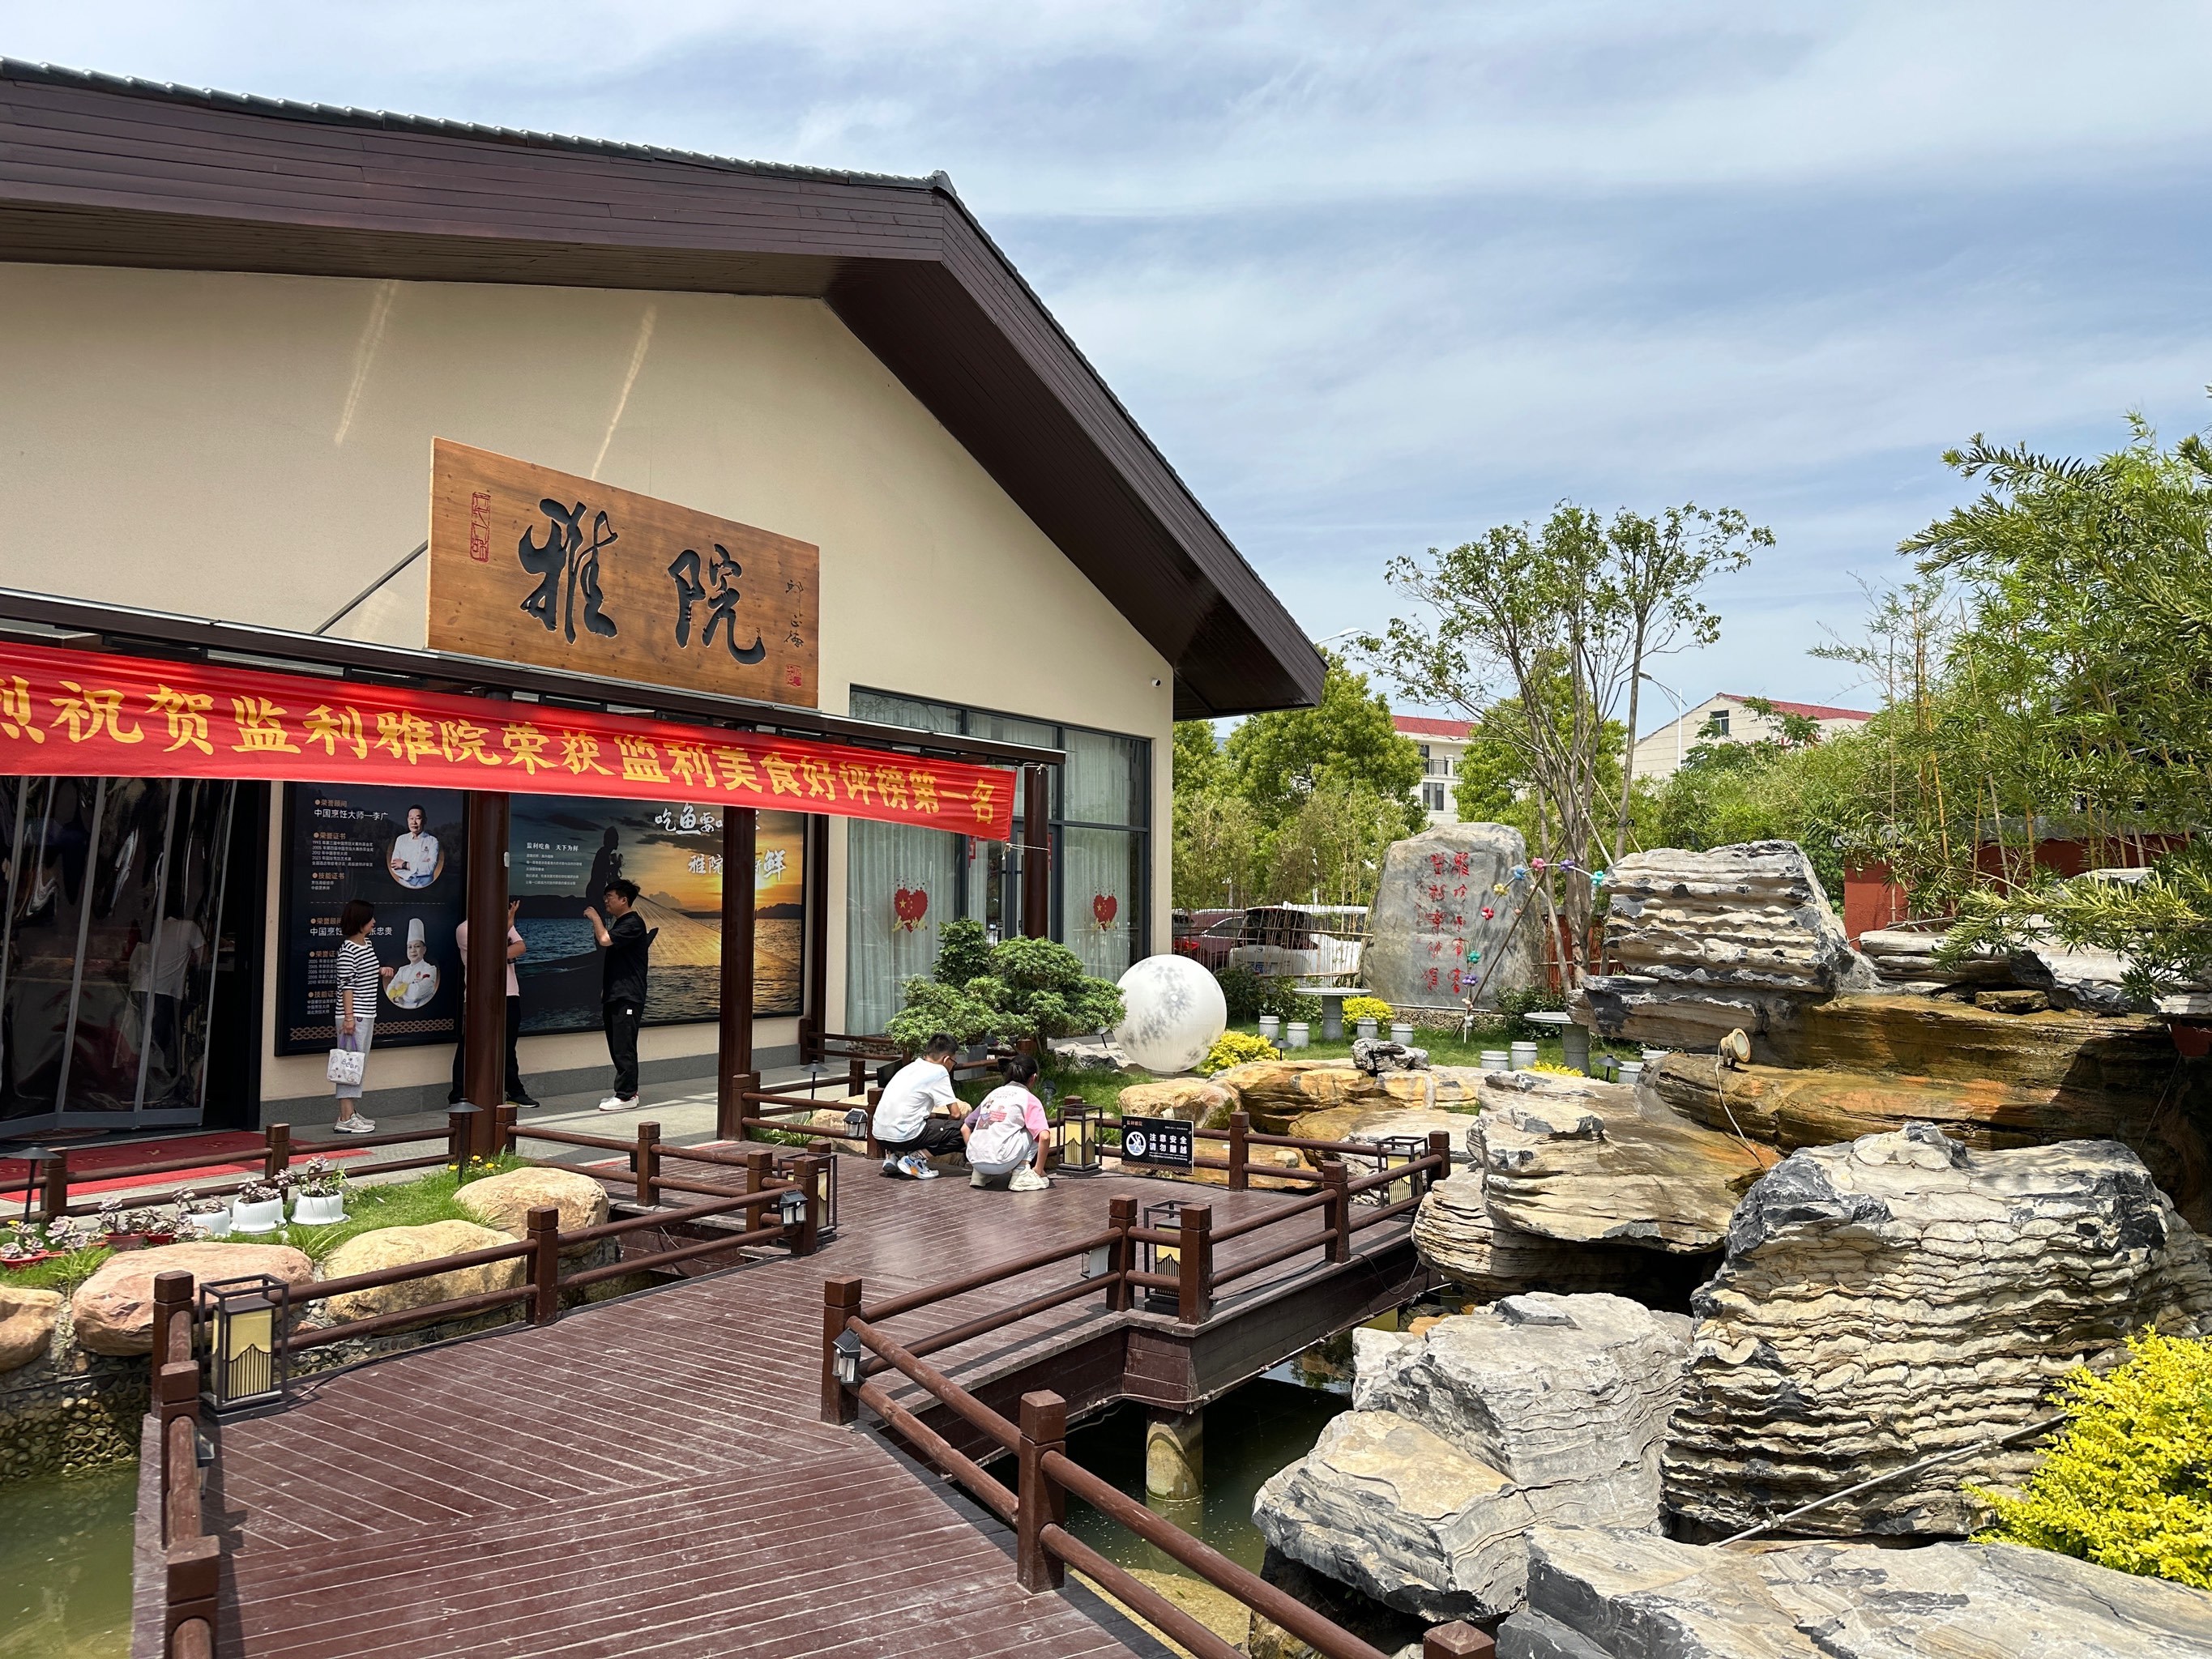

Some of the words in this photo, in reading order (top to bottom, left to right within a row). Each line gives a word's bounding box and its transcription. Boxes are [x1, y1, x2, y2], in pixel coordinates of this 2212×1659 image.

[519, 497, 767, 665] 雅院
[321, 799, 348, 808] 荣誉顾问
[319, 832, 346, 840] 荣誉证书
[526, 842, 550, 850] 监利吃鱼
[556, 844, 579, 852] 天下为鲜
[341, 1058, 359, 1069] Bear
[1149, 1133, 1188, 1145] 注意安全
[1149, 1143, 1188, 1154] 请勿翻越
